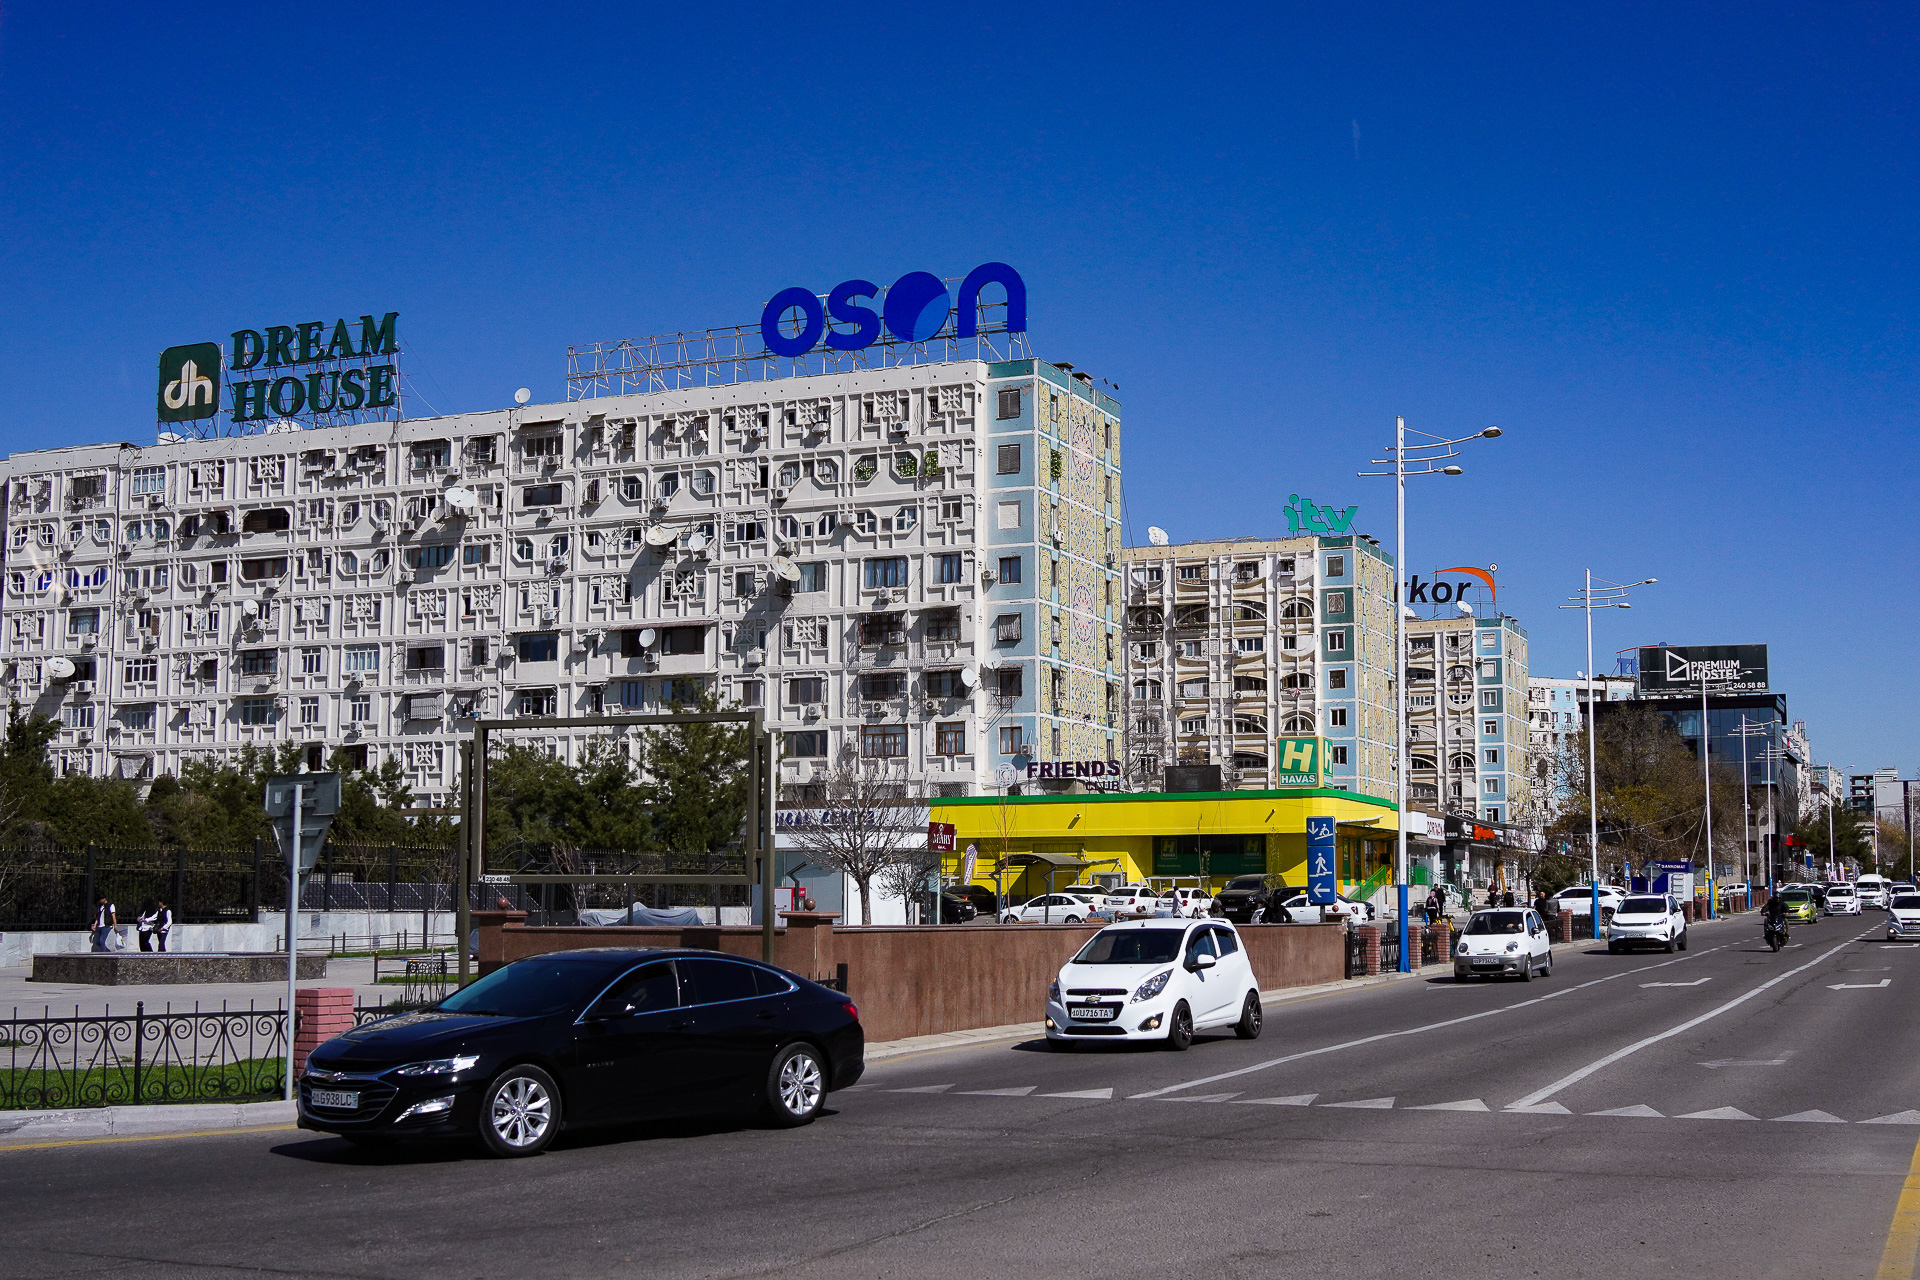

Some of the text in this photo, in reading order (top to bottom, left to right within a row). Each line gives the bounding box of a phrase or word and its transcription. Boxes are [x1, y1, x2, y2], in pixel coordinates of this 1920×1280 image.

[230, 311, 399, 371] DREAM
[231, 364, 396, 422] HOUSE
[1284, 494, 1358, 532] itv
[1691, 660, 1740, 670] PREMIUM
[1691, 669, 1740, 680] HOSTEL
[1282, 740, 1313, 772] H
[1027, 760, 1121, 778] FRIENDS
[1085, 780, 1120, 790] CLUB
[1281, 775, 1315, 784] HAVAS
